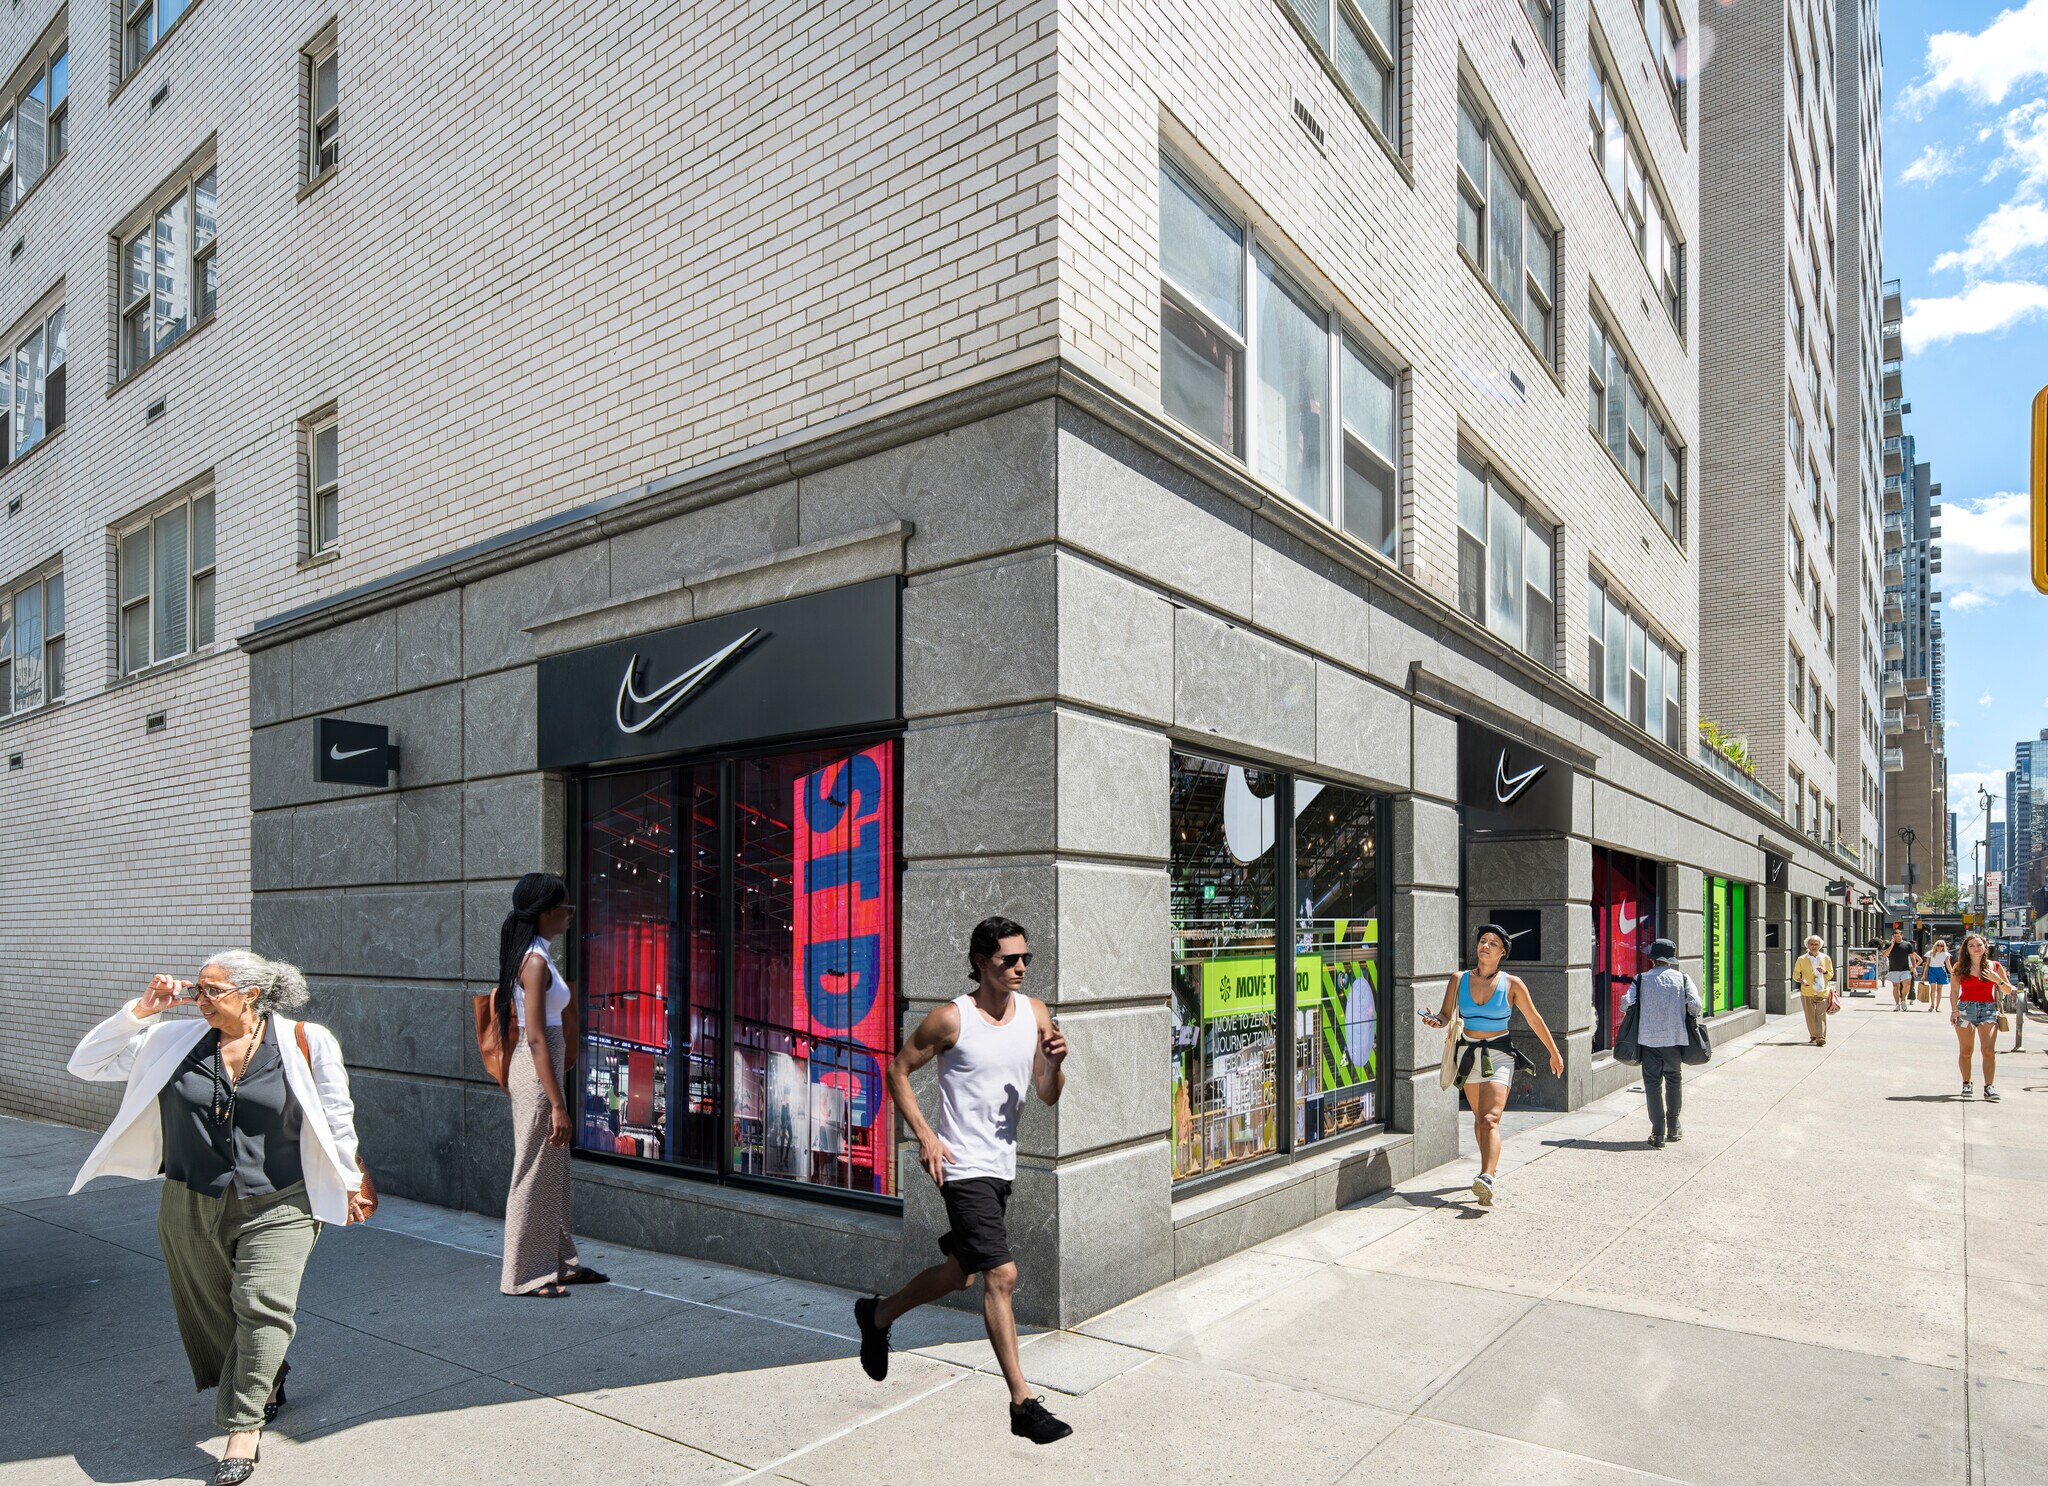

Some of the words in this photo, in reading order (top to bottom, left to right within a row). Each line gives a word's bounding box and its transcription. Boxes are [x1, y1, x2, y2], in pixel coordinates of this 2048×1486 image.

[1236, 974, 1266, 998] MOVE
[1215, 1016, 1237, 1034] MOVE
[1238, 1013, 1249, 1029] TO
[1250, 1010, 1269, 1028] ZERO
[1215, 1033, 1252, 1053] JOURNEY
